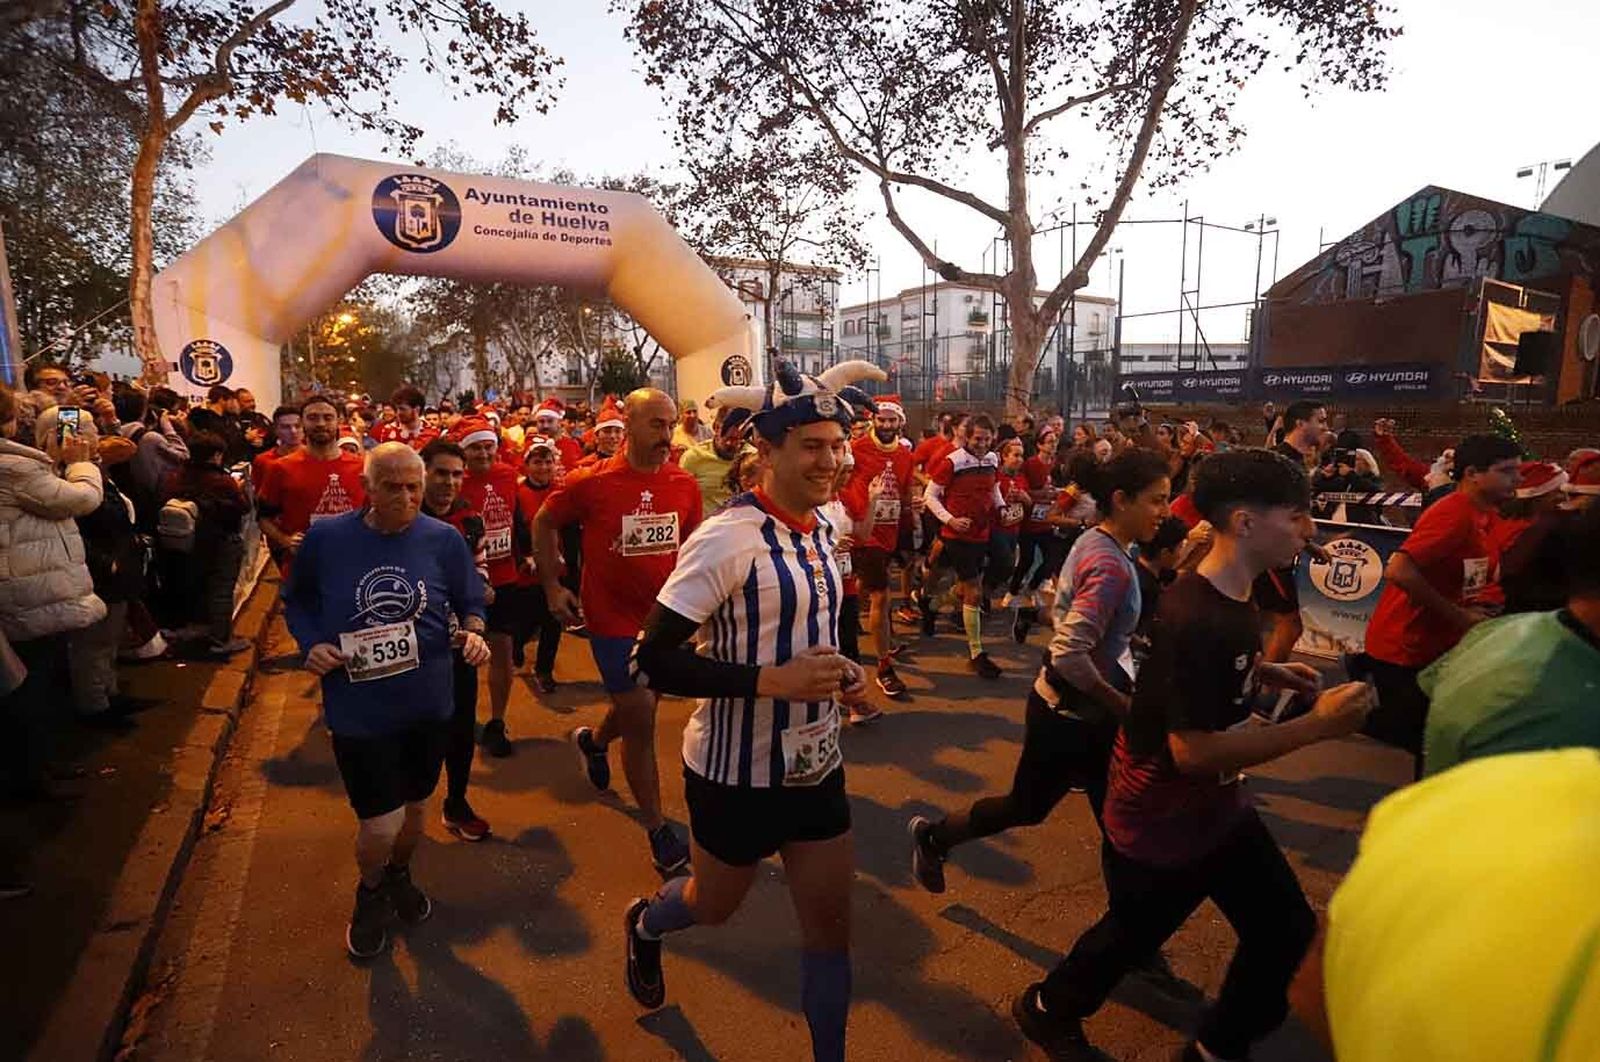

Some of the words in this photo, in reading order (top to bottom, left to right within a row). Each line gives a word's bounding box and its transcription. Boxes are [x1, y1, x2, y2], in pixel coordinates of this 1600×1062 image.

[464, 187, 609, 214] Ayuntamiento
[509, 208, 534, 225] de
[541, 211, 610, 232] Huelva
[542, 231, 557, 242] de
[560, 232, 613, 246] Deportes
[1199, 378, 1241, 388] HYUNDAI
[1282, 374, 1333, 385] HYUNDAI
[1368, 371, 1429, 383] HYUNDAI
[1137, 380, 1173, 390] HYUNDAI
[646, 525, 674, 543] 282
[373, 637, 410, 664] 539
